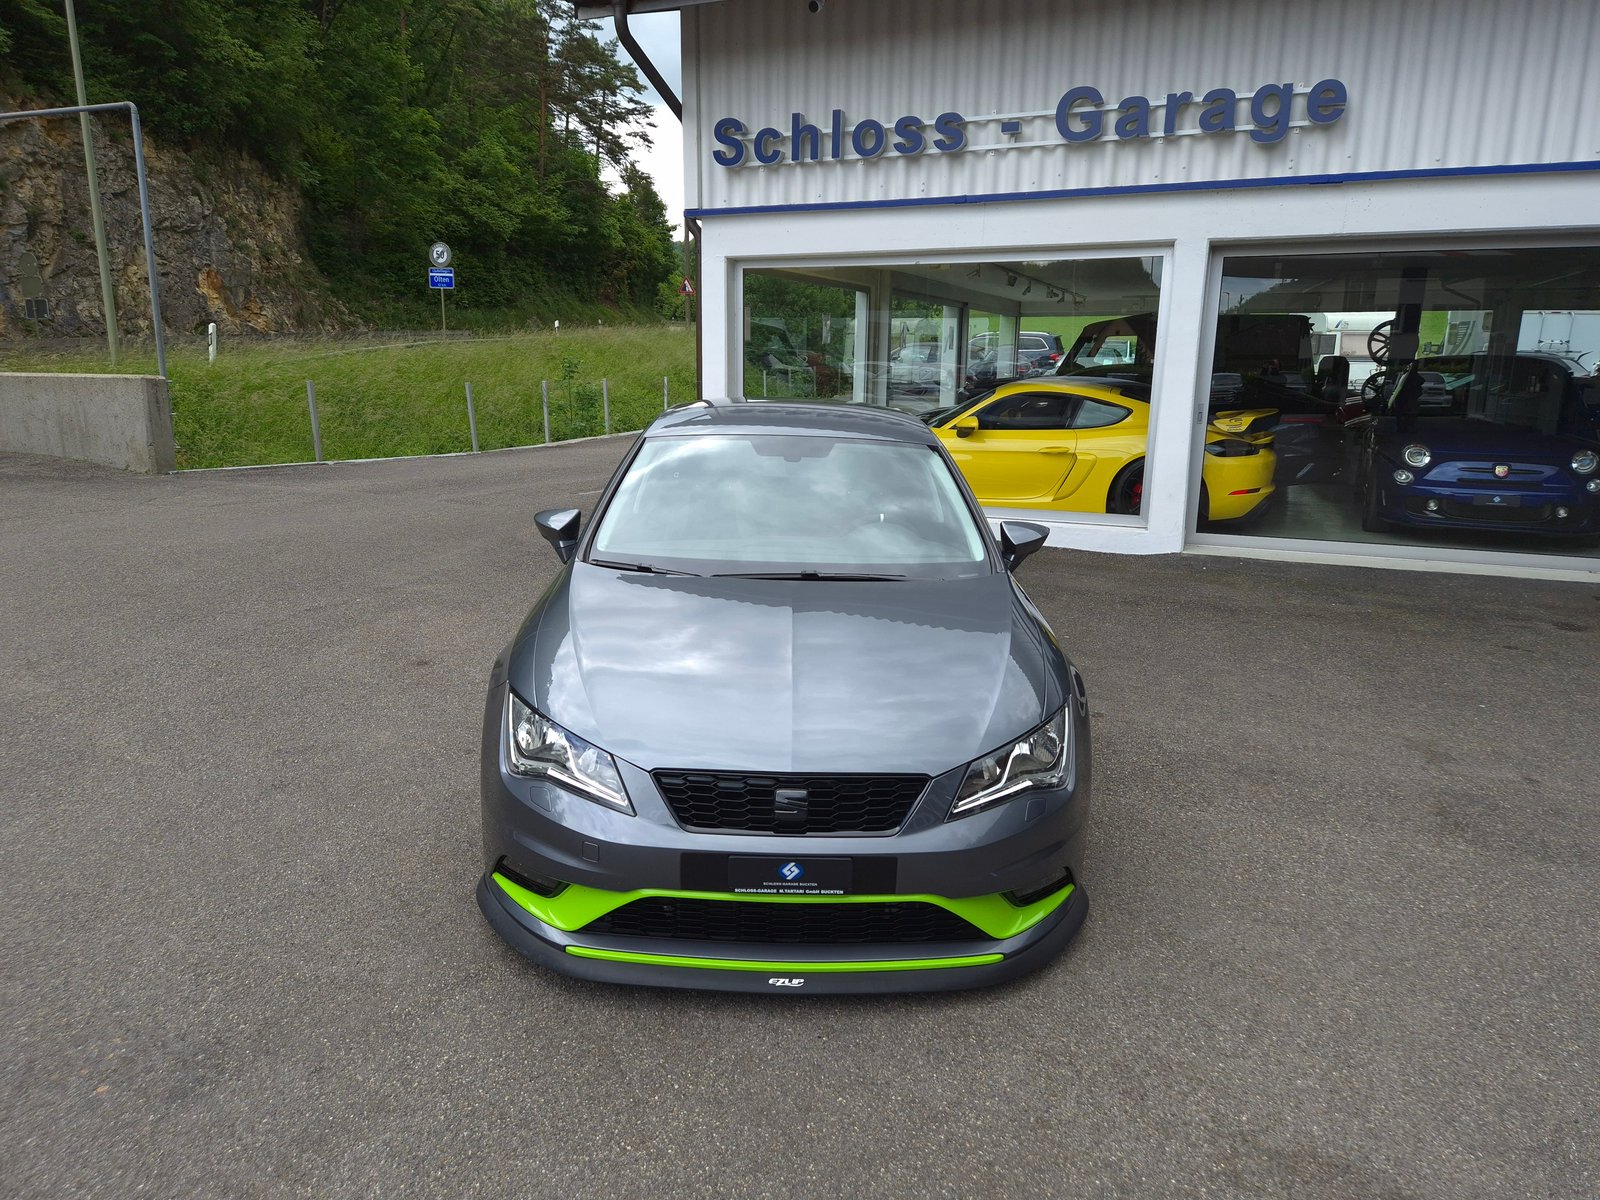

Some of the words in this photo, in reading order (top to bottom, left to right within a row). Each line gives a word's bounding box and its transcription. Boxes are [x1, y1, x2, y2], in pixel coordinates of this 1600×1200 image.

[712, 109, 968, 168] Schloss
[1055, 78, 1348, 144] Garage
[435, 250, 445, 259] 50
